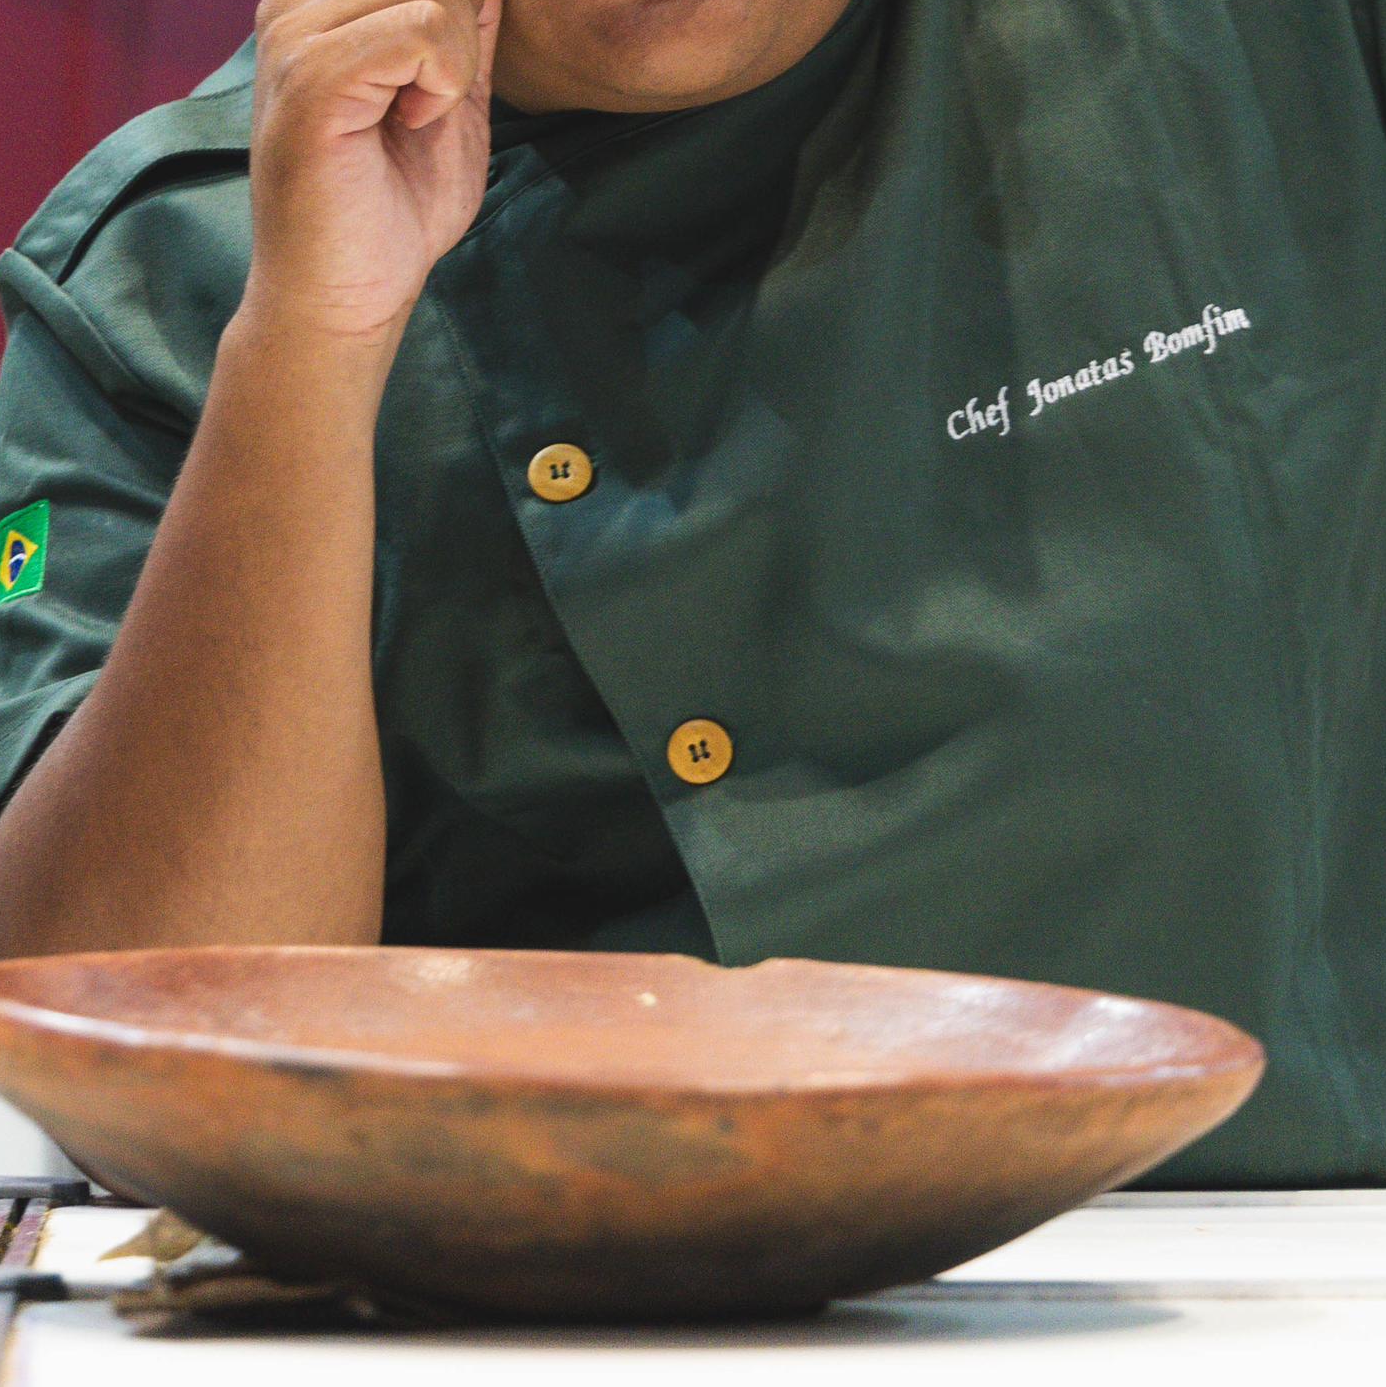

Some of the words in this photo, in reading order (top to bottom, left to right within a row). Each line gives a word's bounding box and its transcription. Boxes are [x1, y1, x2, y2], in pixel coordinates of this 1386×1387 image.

[946, 385, 1011, 440] Chef
[1026, 348, 1135, 416] Jonatas
[1143, 303, 1251, 363] Bomfim
